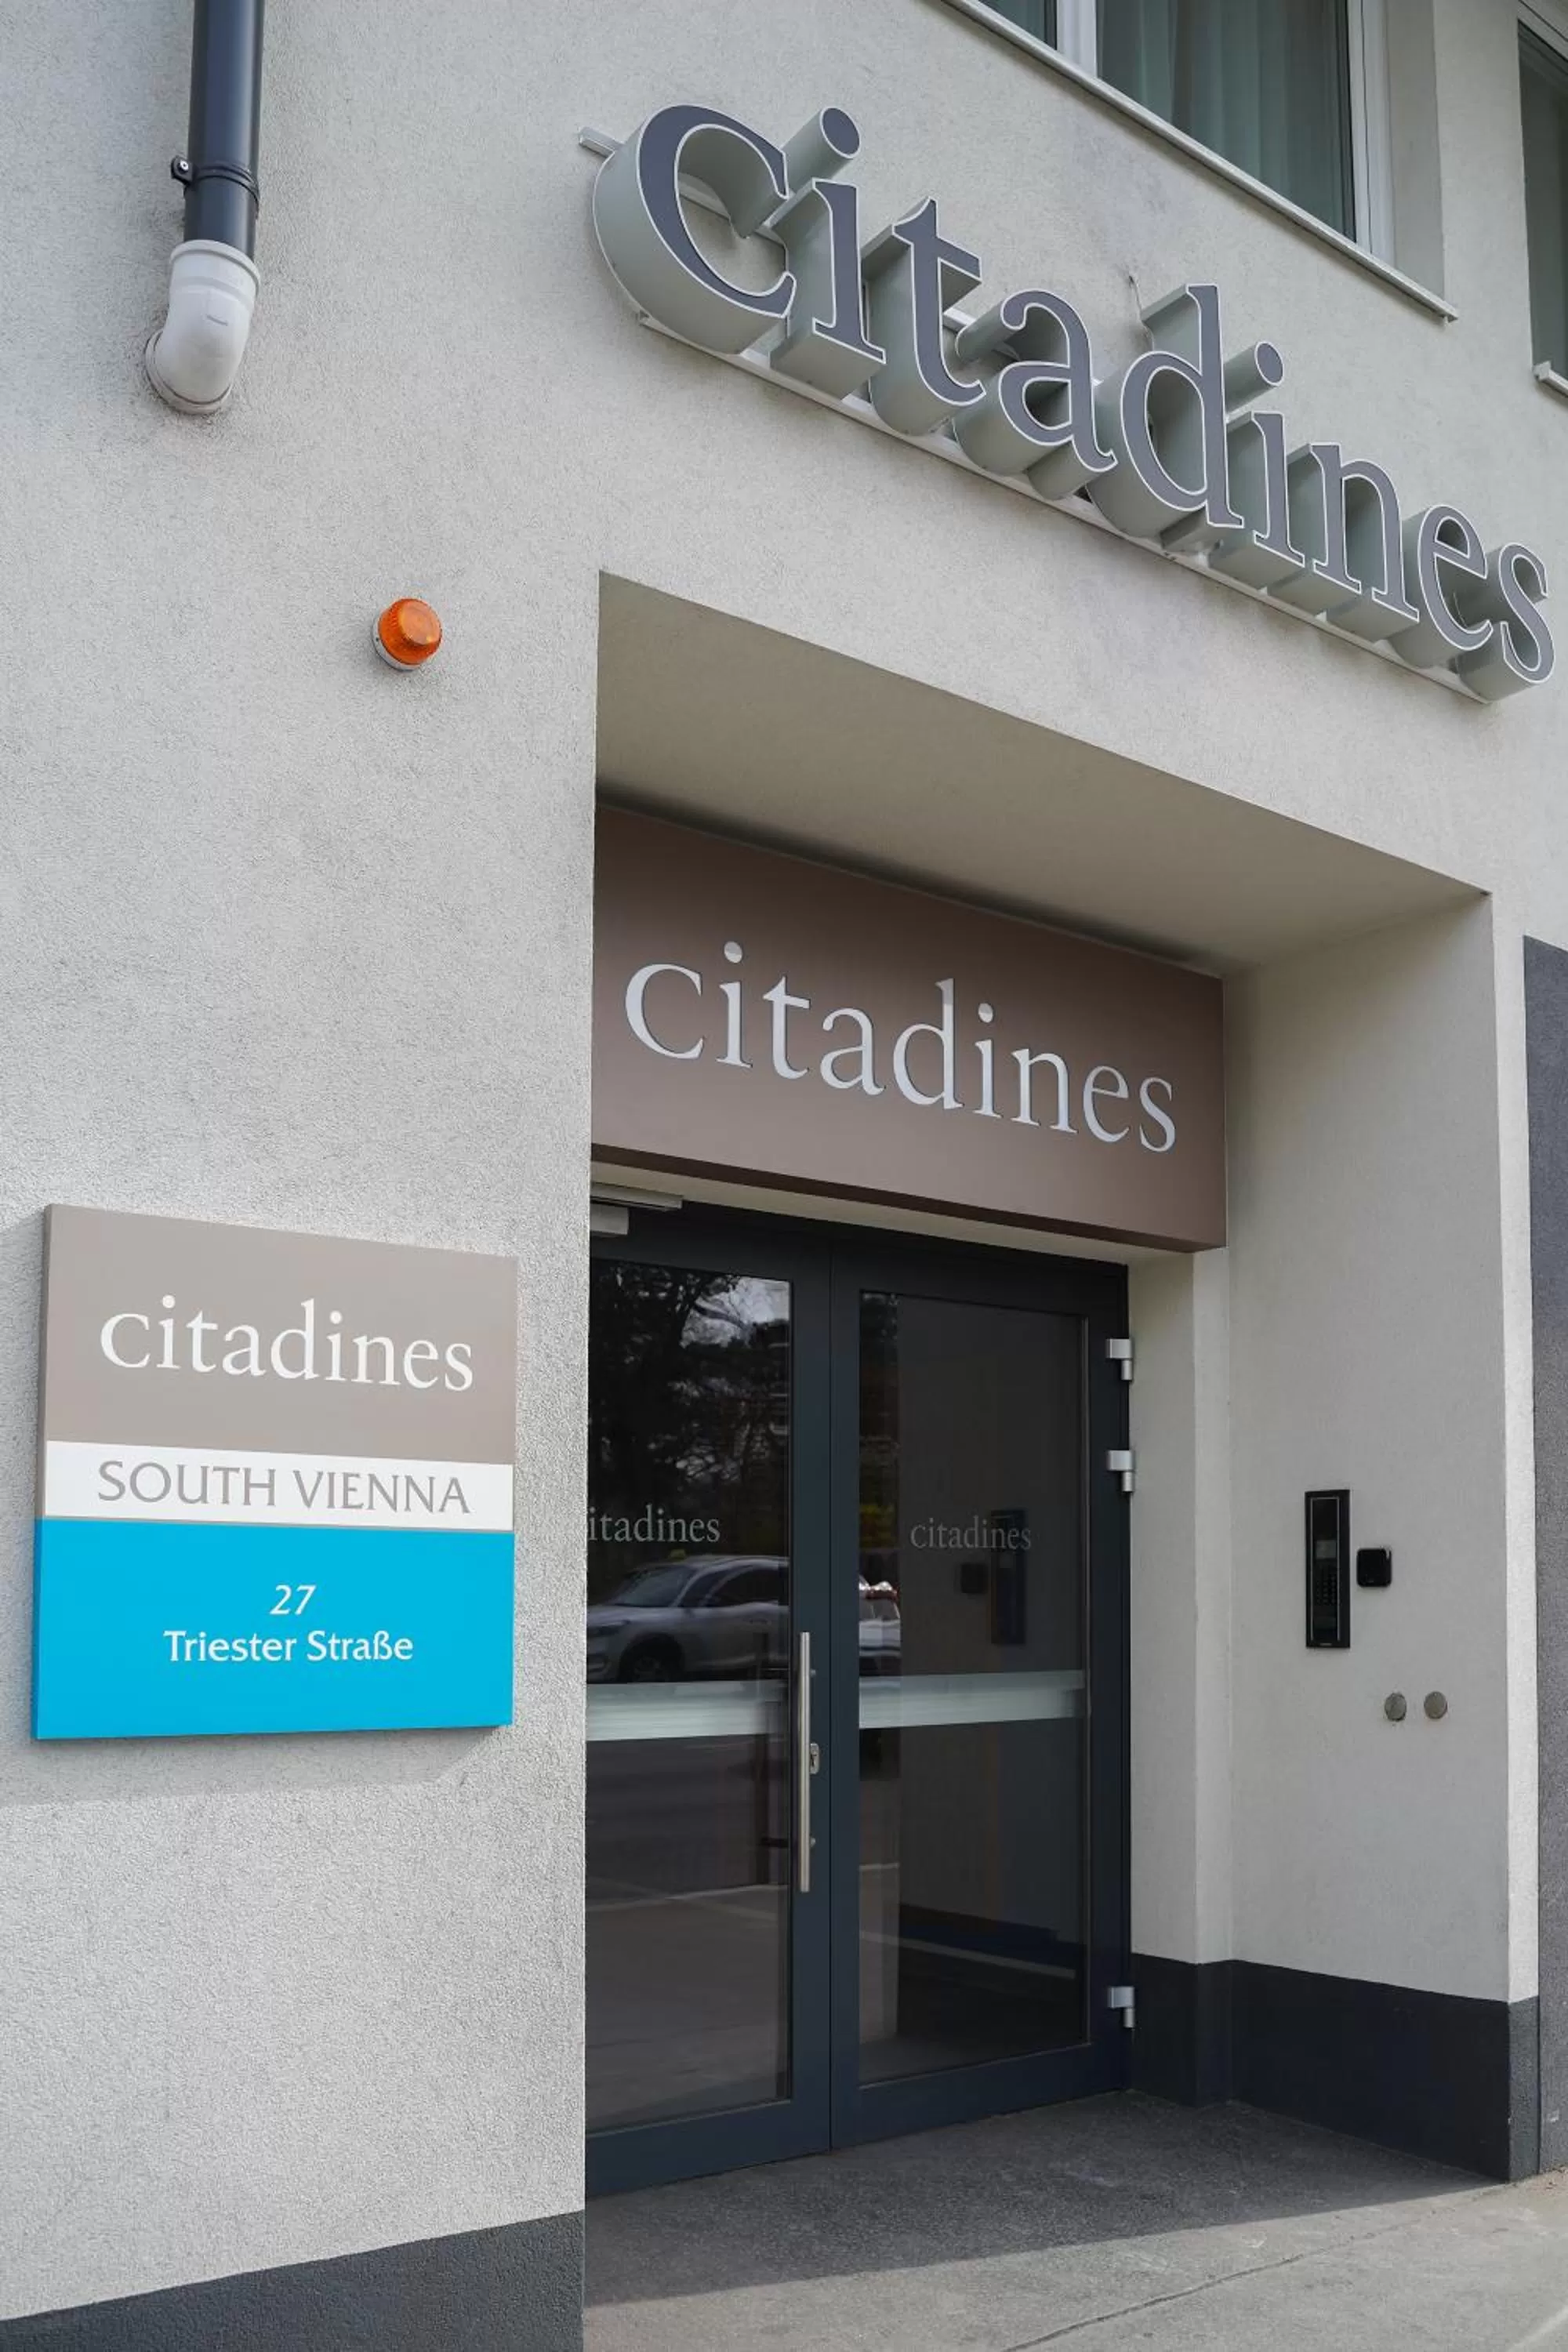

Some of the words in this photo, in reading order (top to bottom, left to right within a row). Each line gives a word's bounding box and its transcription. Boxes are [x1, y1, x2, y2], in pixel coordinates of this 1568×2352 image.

[98, 1460, 277, 1507] SOUTH
[293, 1469, 471, 1514] VIENNA
[587, 1502, 720, 1543] itadines
[269, 1584, 317, 1616] 27
[163, 1630, 297, 1663] Triester
[307, 1630, 414, 1662] Straße
